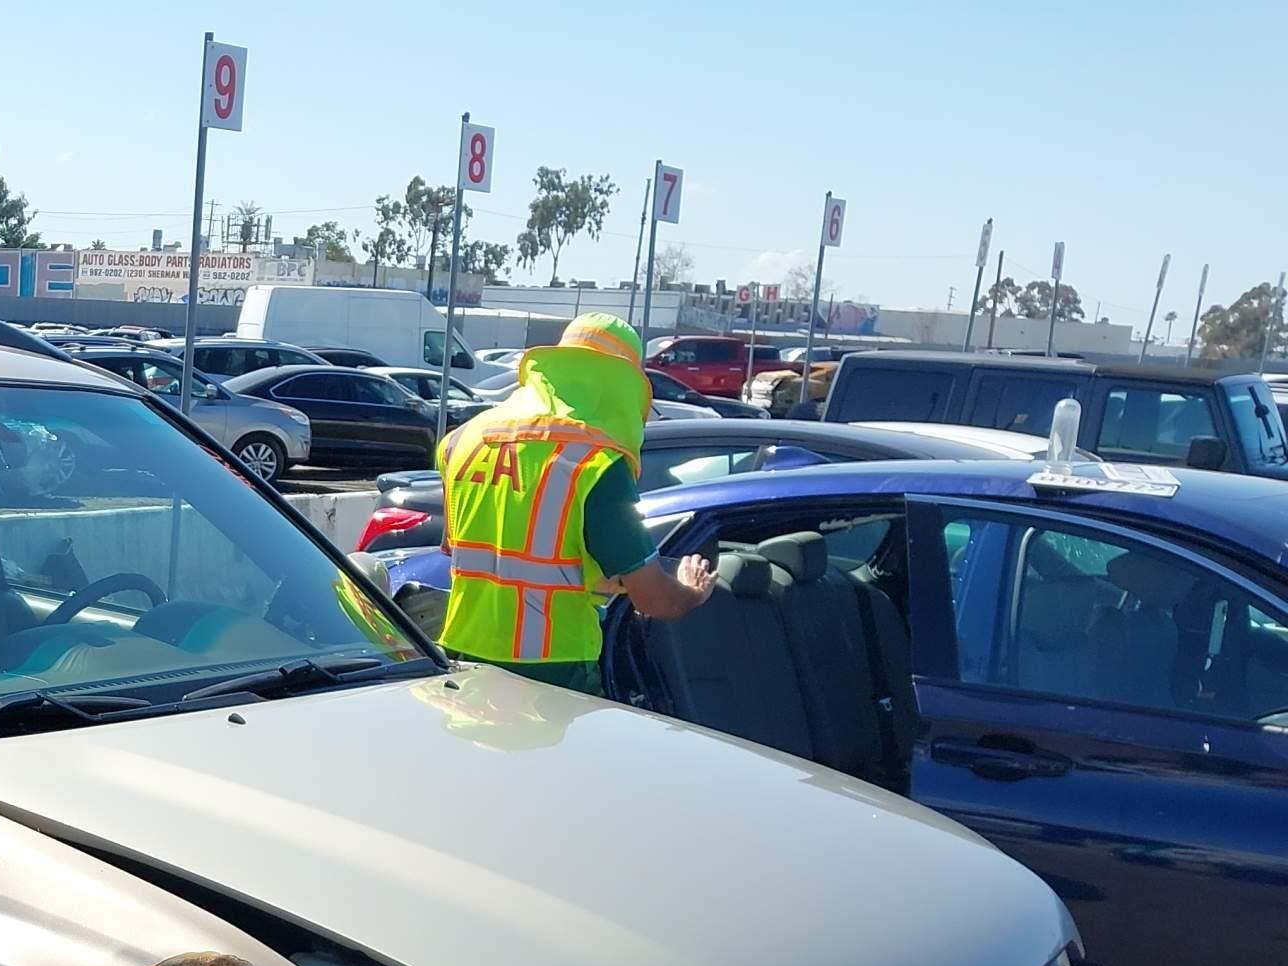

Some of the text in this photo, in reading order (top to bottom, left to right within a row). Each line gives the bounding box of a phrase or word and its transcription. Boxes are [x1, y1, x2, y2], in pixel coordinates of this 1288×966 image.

[215, 55, 235, 119] 9
[468, 132, 487, 184] 8
[663, 172, 678, 216] 7
[828, 204, 841, 241] 6
[82, 253, 105, 266] AUTO
[147, 269, 181, 279] SHERMAN
[738, 286, 750, 302] G
[767, 286, 778, 300] H
